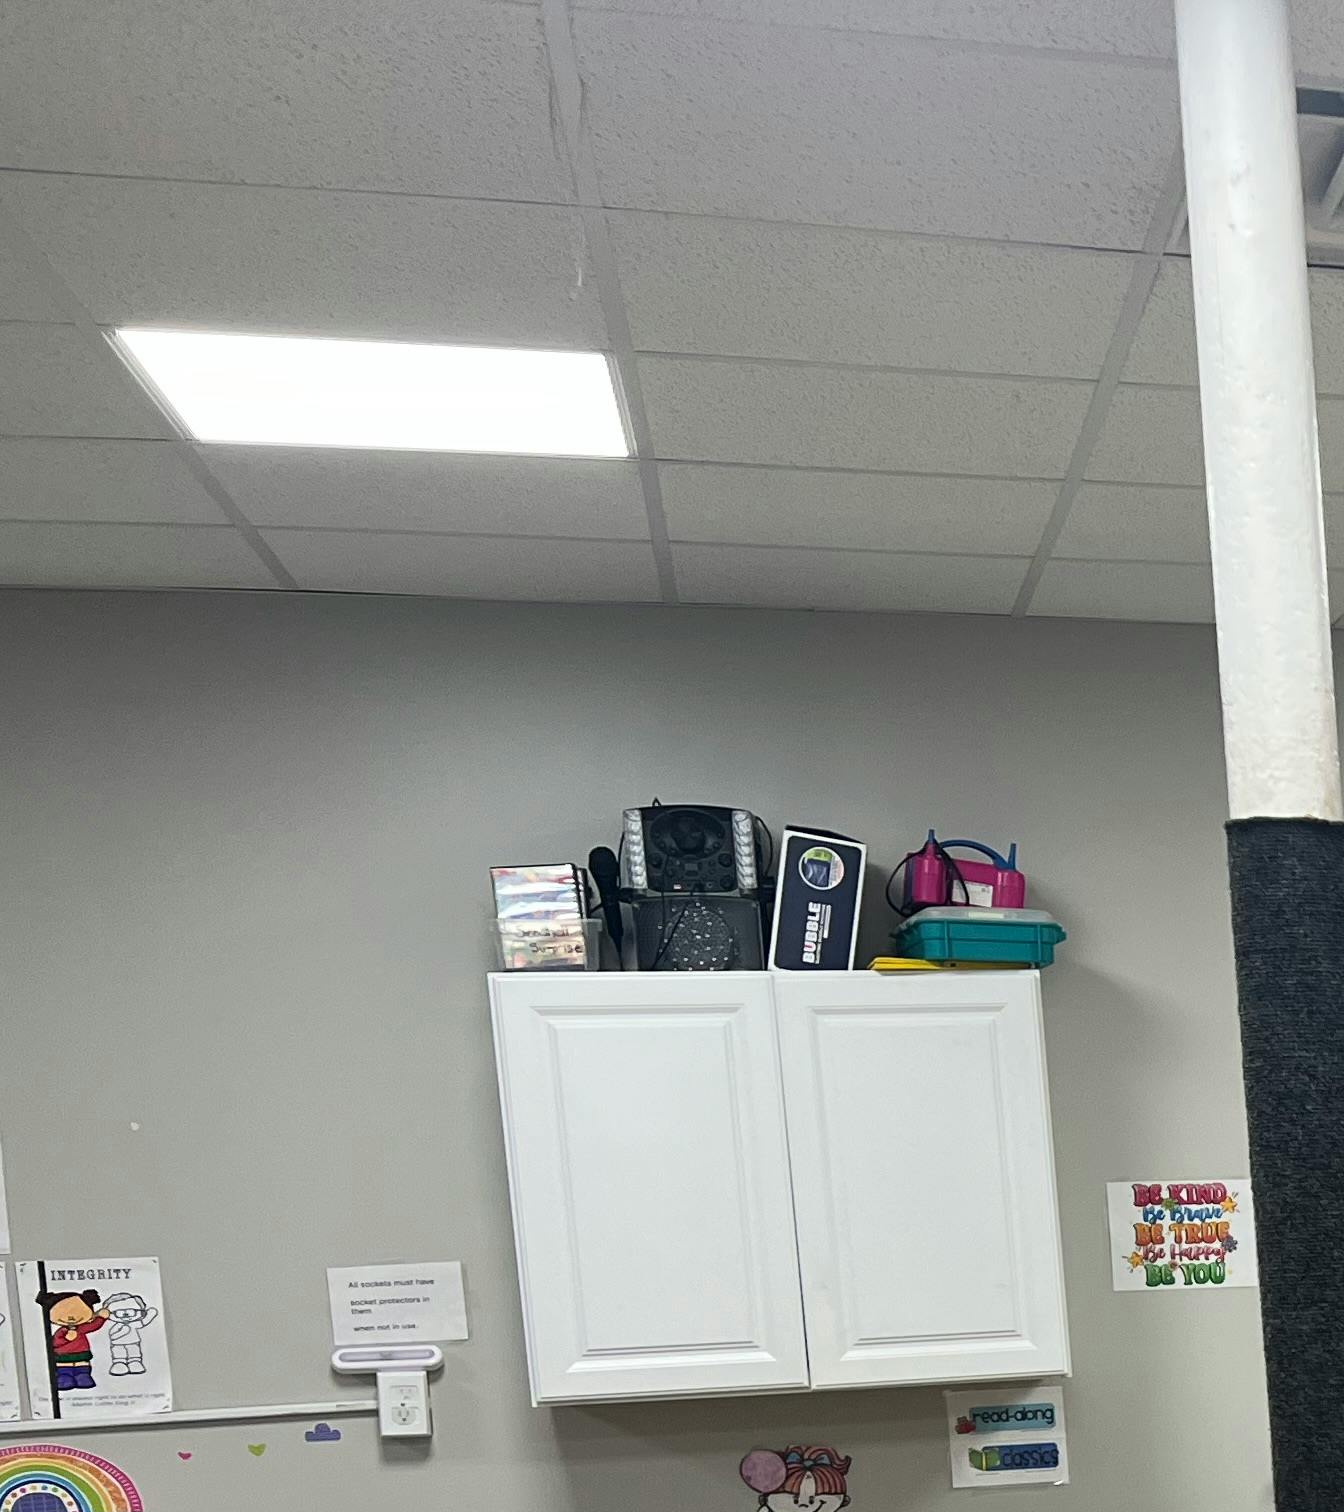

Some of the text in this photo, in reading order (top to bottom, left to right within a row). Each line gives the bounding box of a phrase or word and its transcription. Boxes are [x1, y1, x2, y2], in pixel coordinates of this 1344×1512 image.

[802, 902, 821, 964] BUBBLE
[1132, 1182, 1228, 1207] BE KIND
[1142, 1206, 1223, 1223] Be Brave
[1133, 1221, 1230, 1246] BE TRUE
[1142, 1244, 1227, 1264] Be Happy
[50, 1268, 132, 1281] INTEGRITY
[393, 1279, 413, 1287] must
[415, 1278, 434, 1286] have
[1144, 1262, 1226, 1287] BE YOU
[378, 1297, 421, 1306] protectors
[971, 1407, 1055, 1425] read-along
